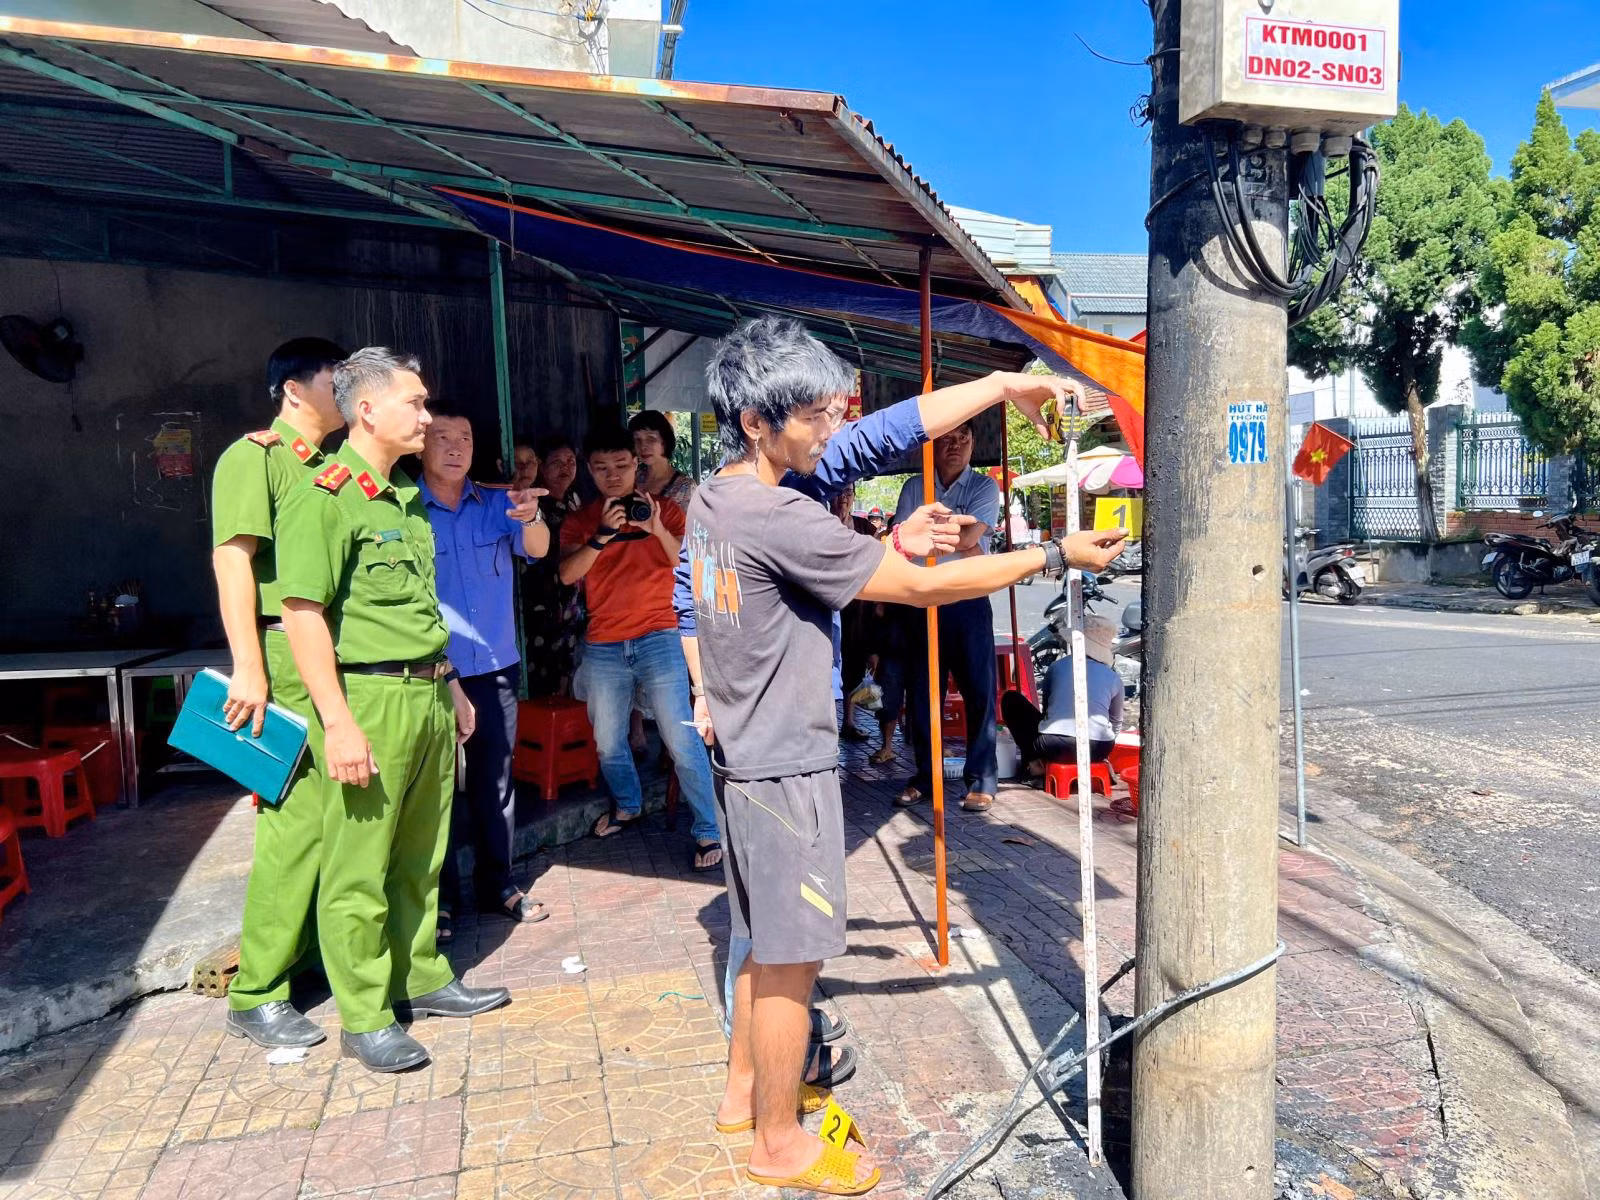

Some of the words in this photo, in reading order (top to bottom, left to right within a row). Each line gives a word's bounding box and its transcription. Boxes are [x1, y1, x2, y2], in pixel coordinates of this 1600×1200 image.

[1262, 24, 1367, 51] KTM0001
[1248, 56, 1382, 85] DN02-SN03
[1112, 504, 1126, 528] 1
[827, 1114, 841, 1143] 2
